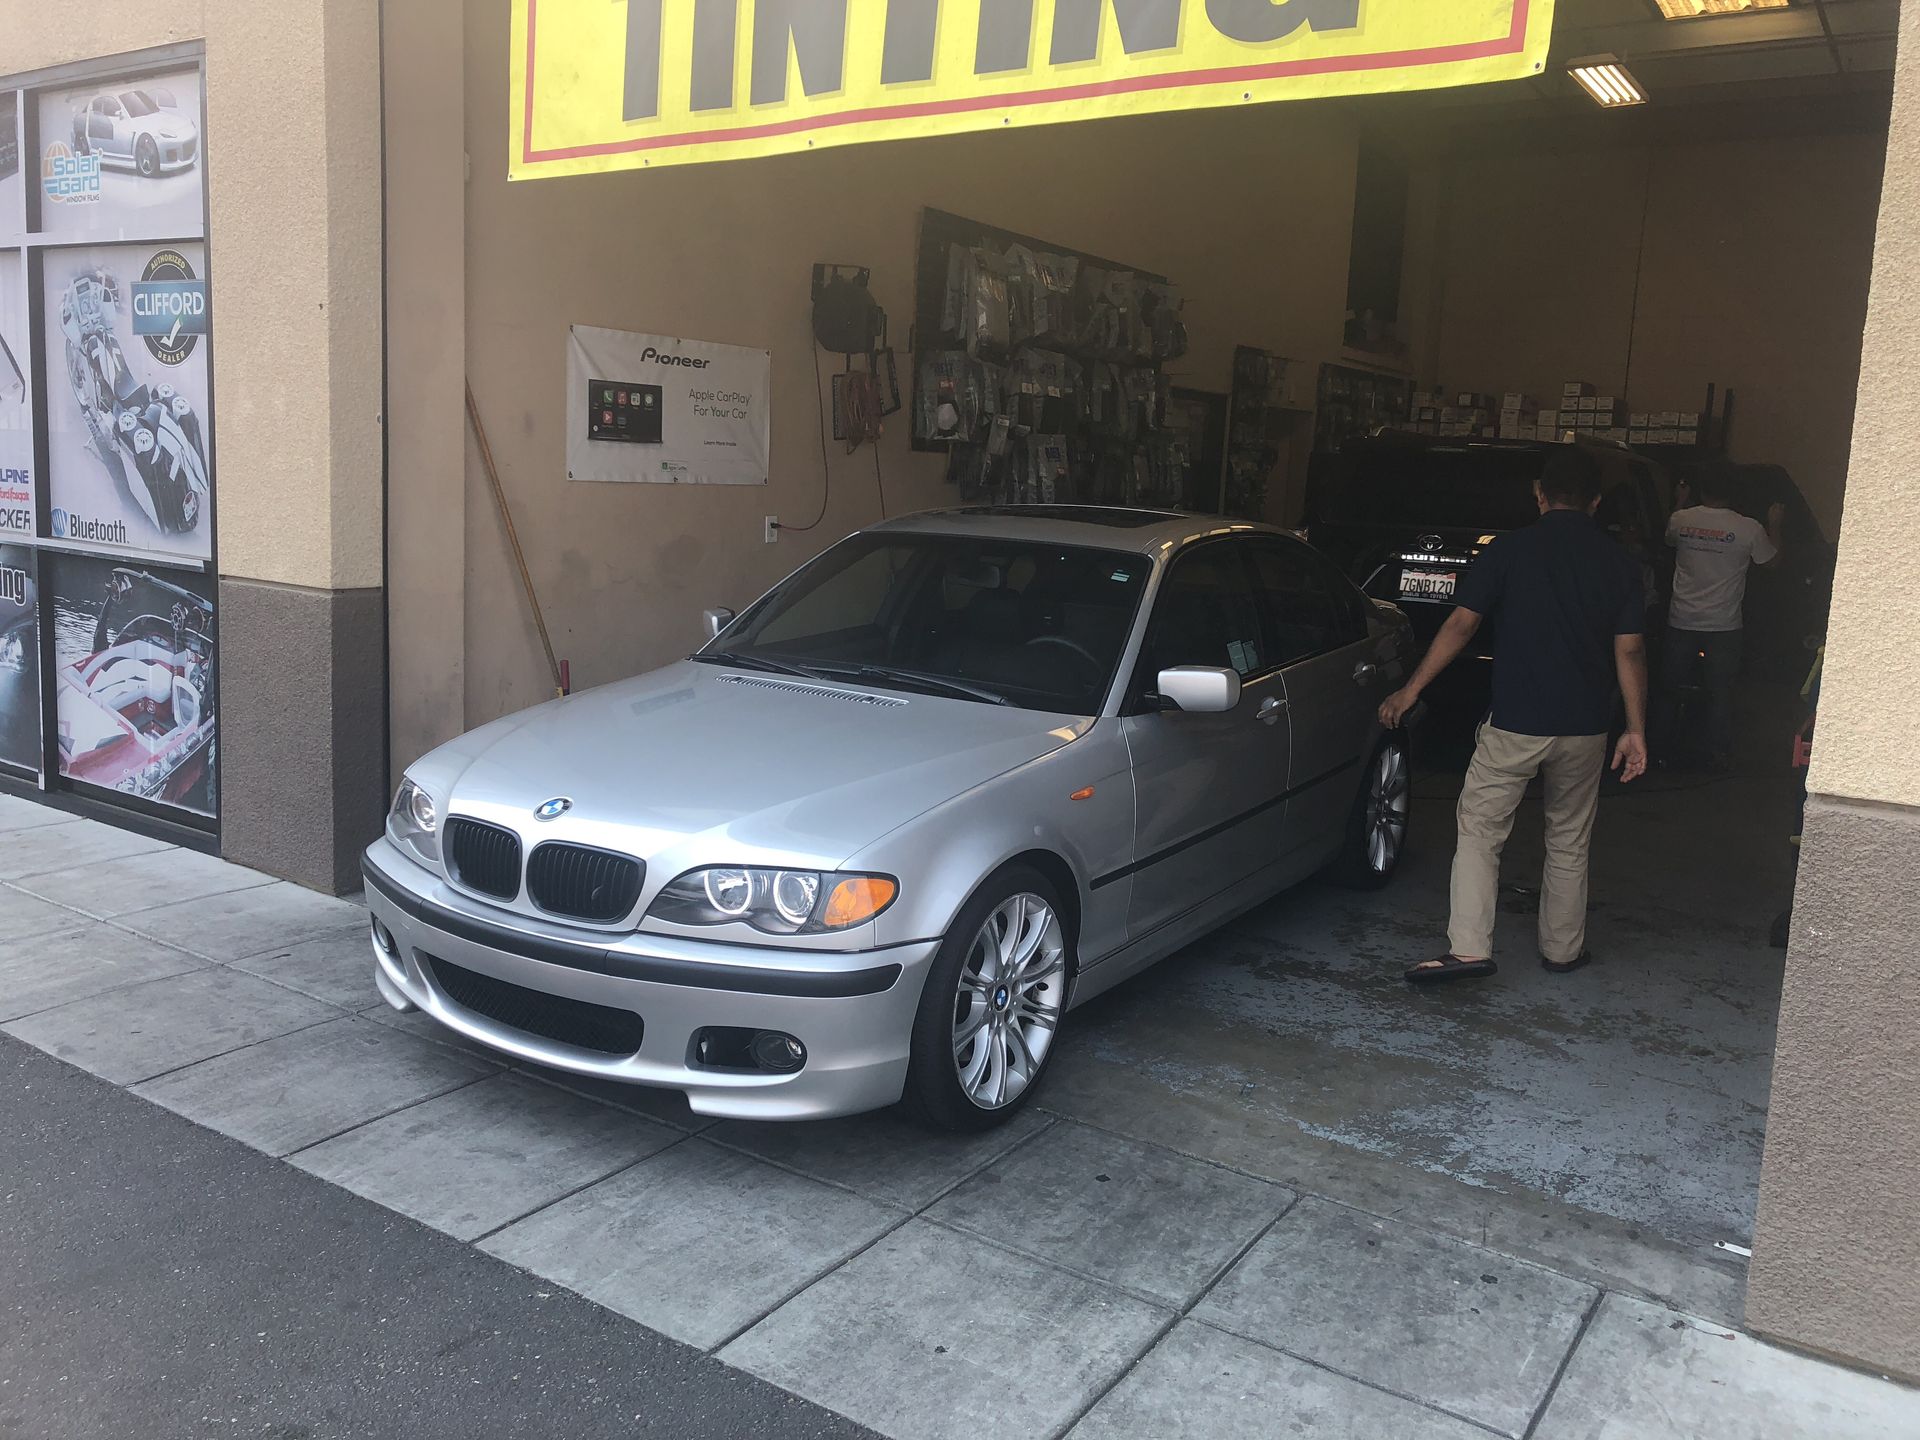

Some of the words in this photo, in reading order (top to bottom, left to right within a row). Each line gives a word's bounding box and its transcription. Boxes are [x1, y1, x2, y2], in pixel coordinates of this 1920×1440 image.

[54, 153, 98, 176] Solar
[58, 164, 100, 195] Gard
[151, 254, 186, 270] AUTHORIZED
[134, 291, 204, 316] CLIFFORD
[157, 350, 186, 363] DEALER
[640, 347, 710, 369] Pioneer
[689, 388, 714, 402] Apple
[693, 405, 708, 416] For
[710, 406, 729, 418] Your
[732, 408, 748, 419] Car
[1403, 578, 1453, 594] 7GNB120
